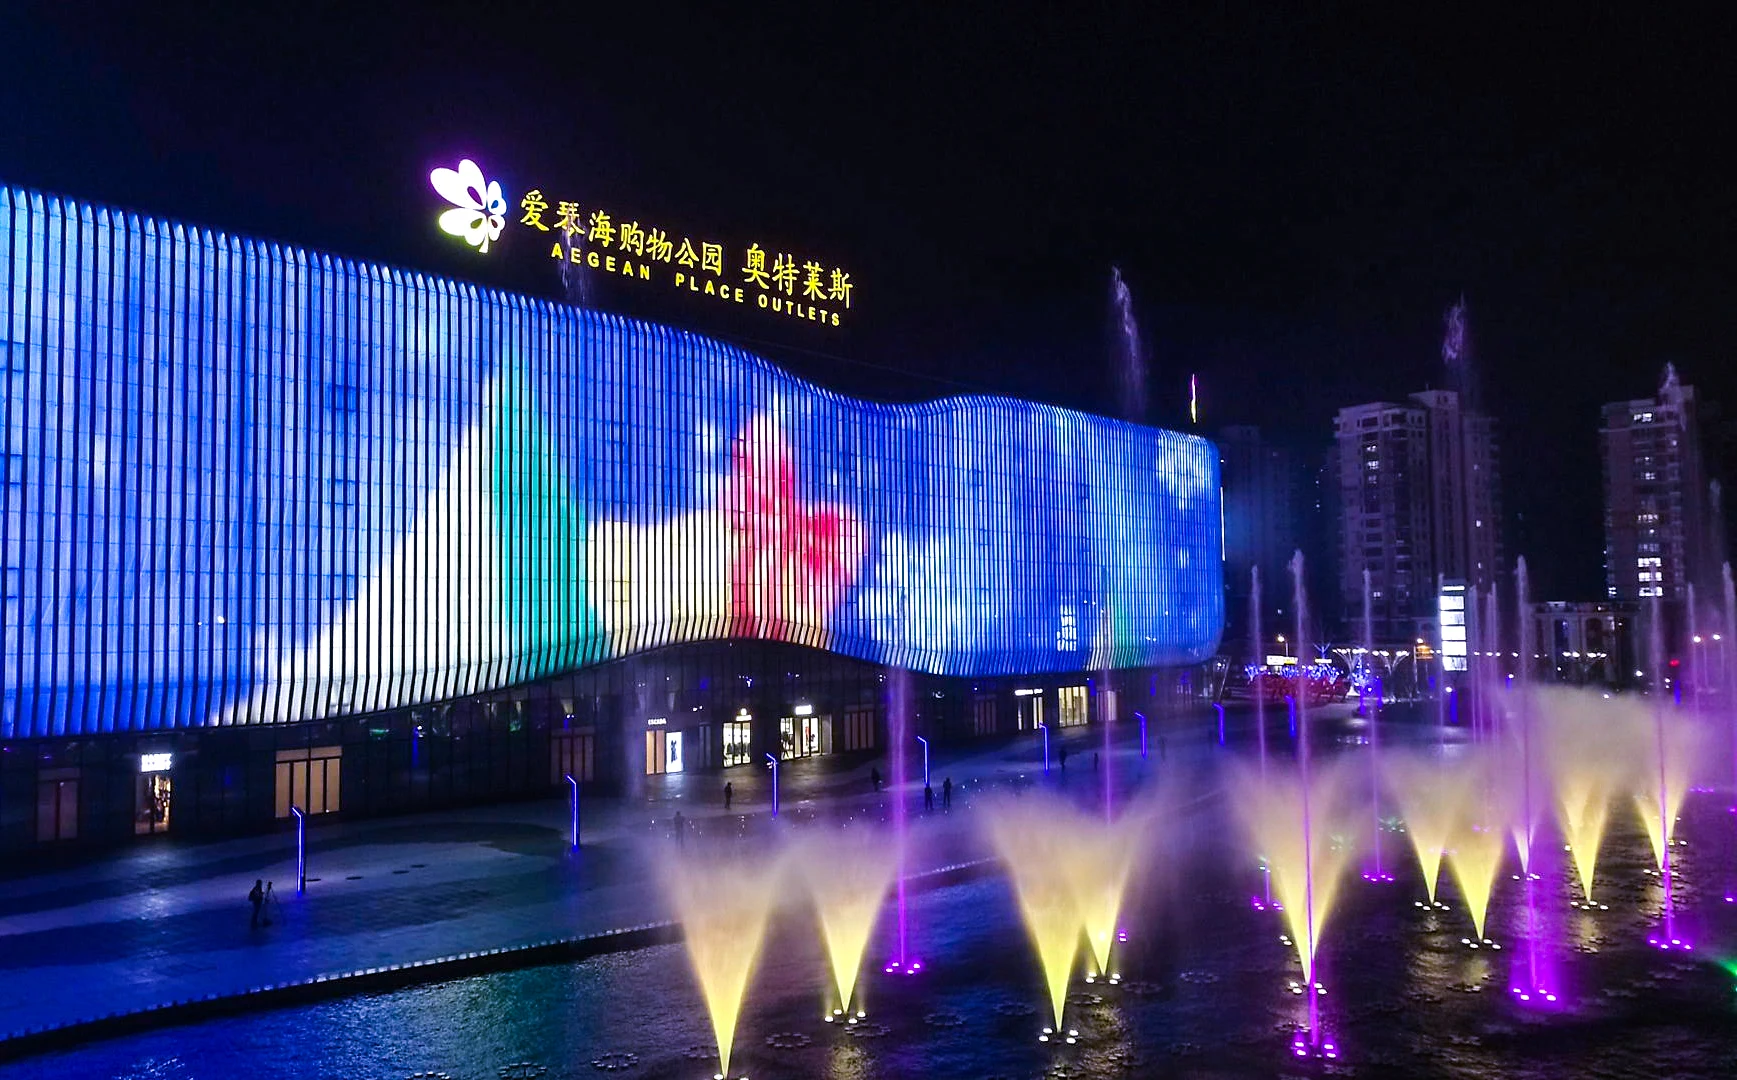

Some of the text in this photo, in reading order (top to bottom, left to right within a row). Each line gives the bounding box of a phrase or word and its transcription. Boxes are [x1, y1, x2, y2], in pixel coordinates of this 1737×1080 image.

[520, 189, 853, 309] 爱琴海购物公园 奥特莱斯
[551, 242, 840, 327] AEGEAN PLACE OUTLETS
